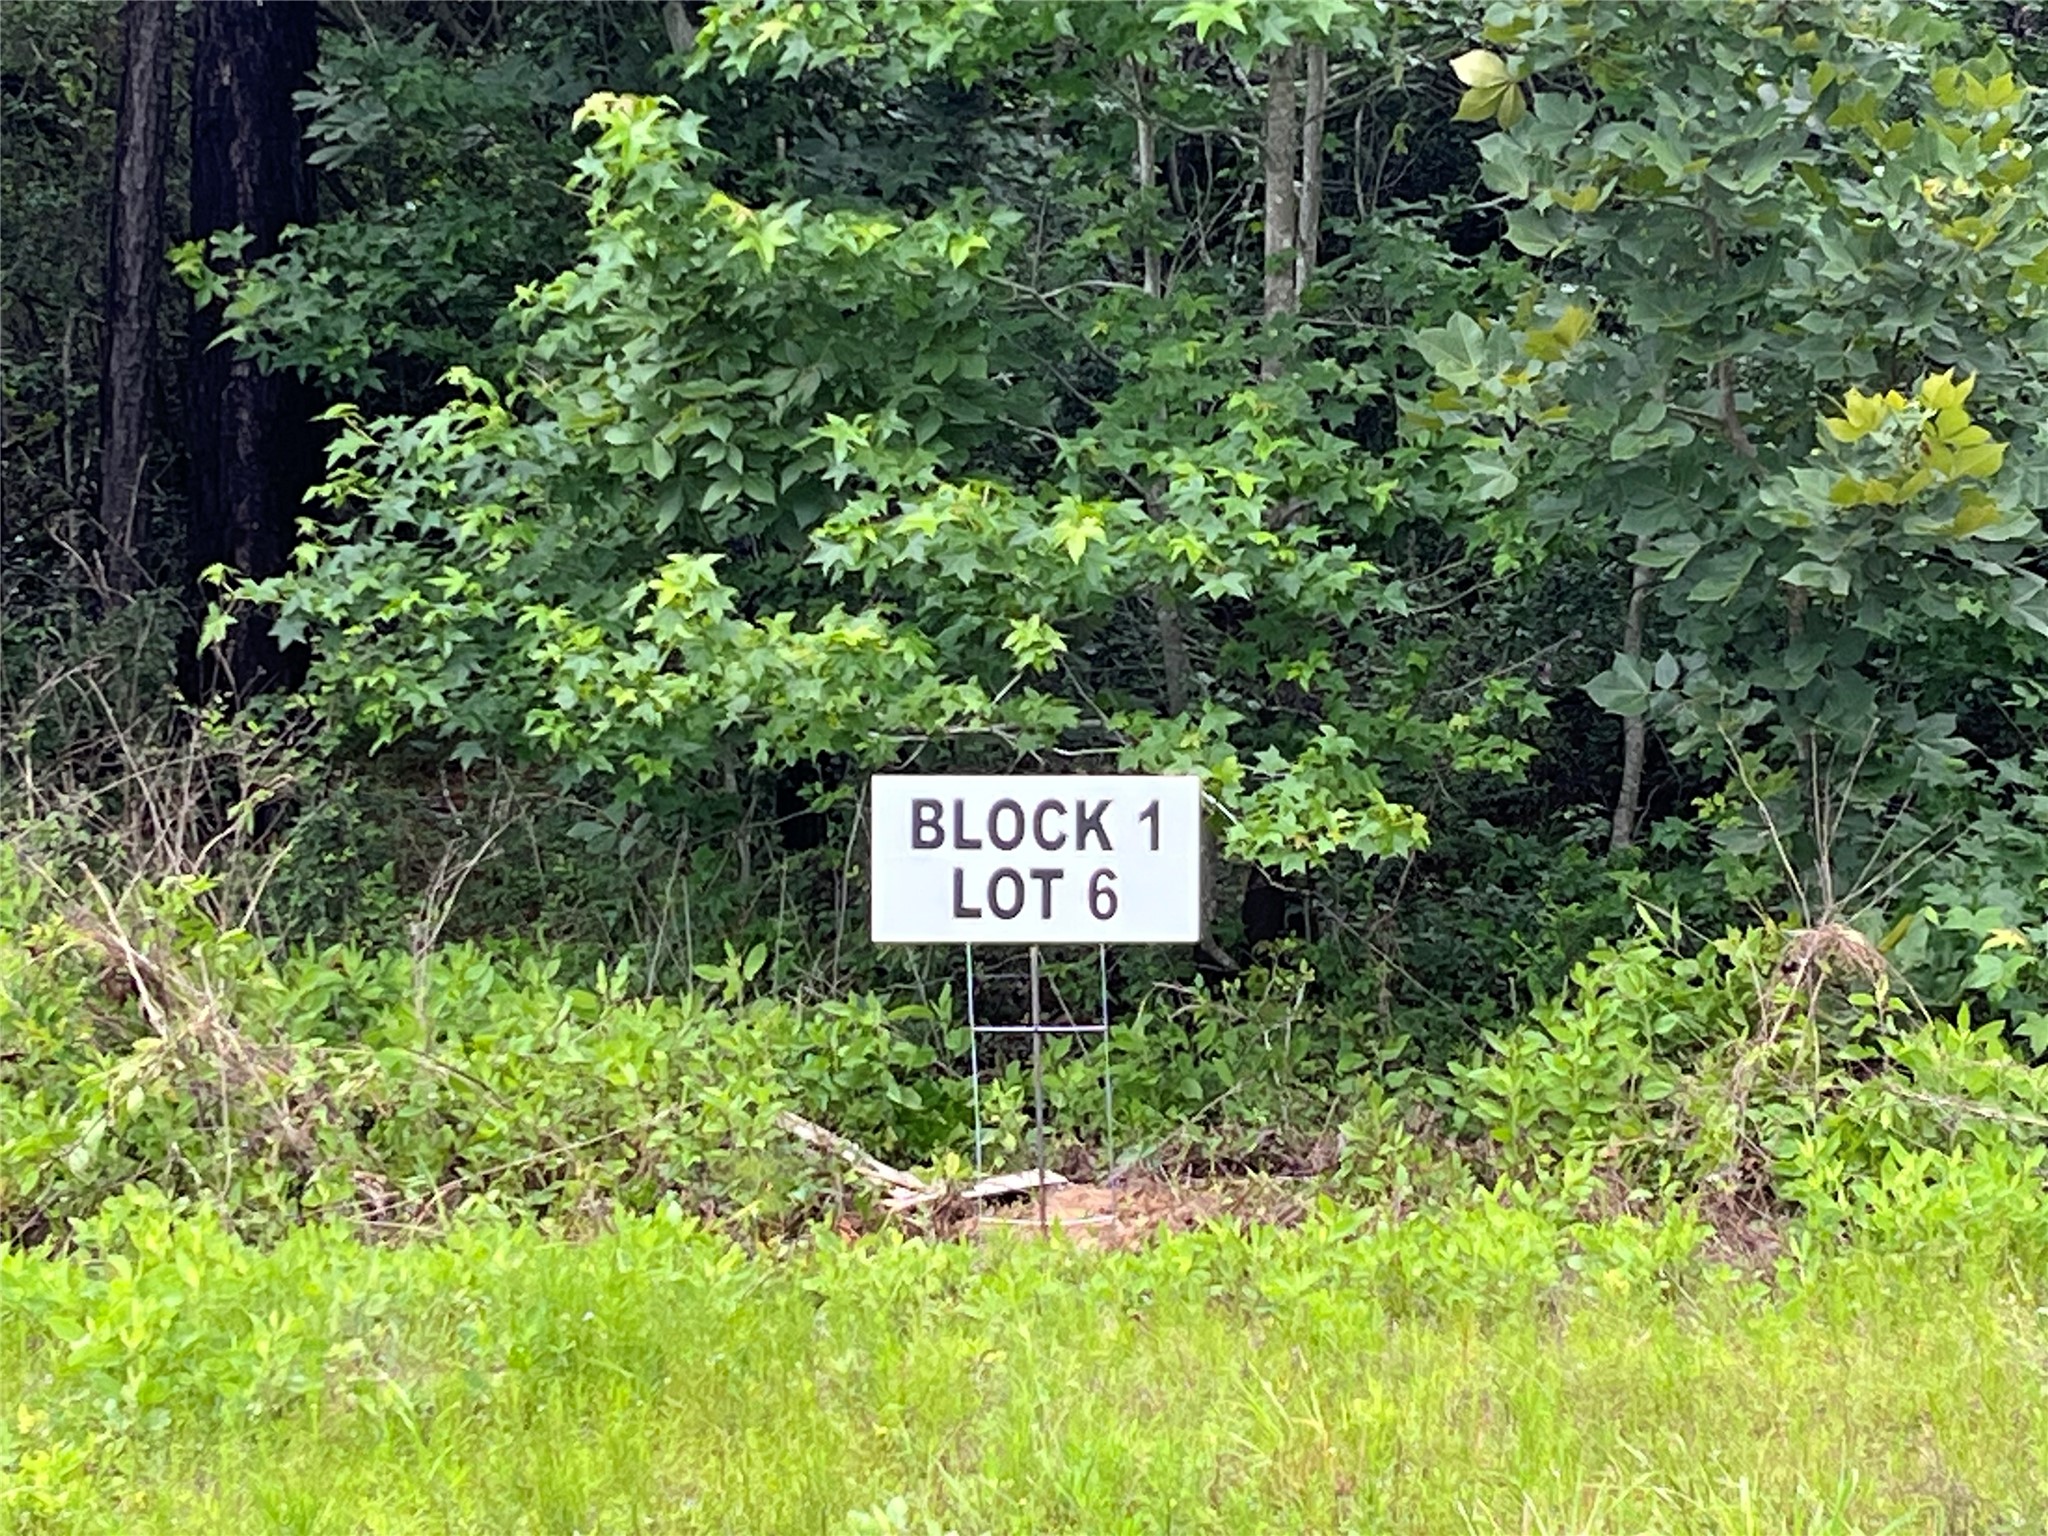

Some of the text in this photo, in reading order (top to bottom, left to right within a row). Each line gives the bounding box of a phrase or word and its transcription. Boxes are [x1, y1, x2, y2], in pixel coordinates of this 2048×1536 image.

[911, 798, 1160, 851] BLOCK 1
[952, 867, 1118, 921] LOT 6
